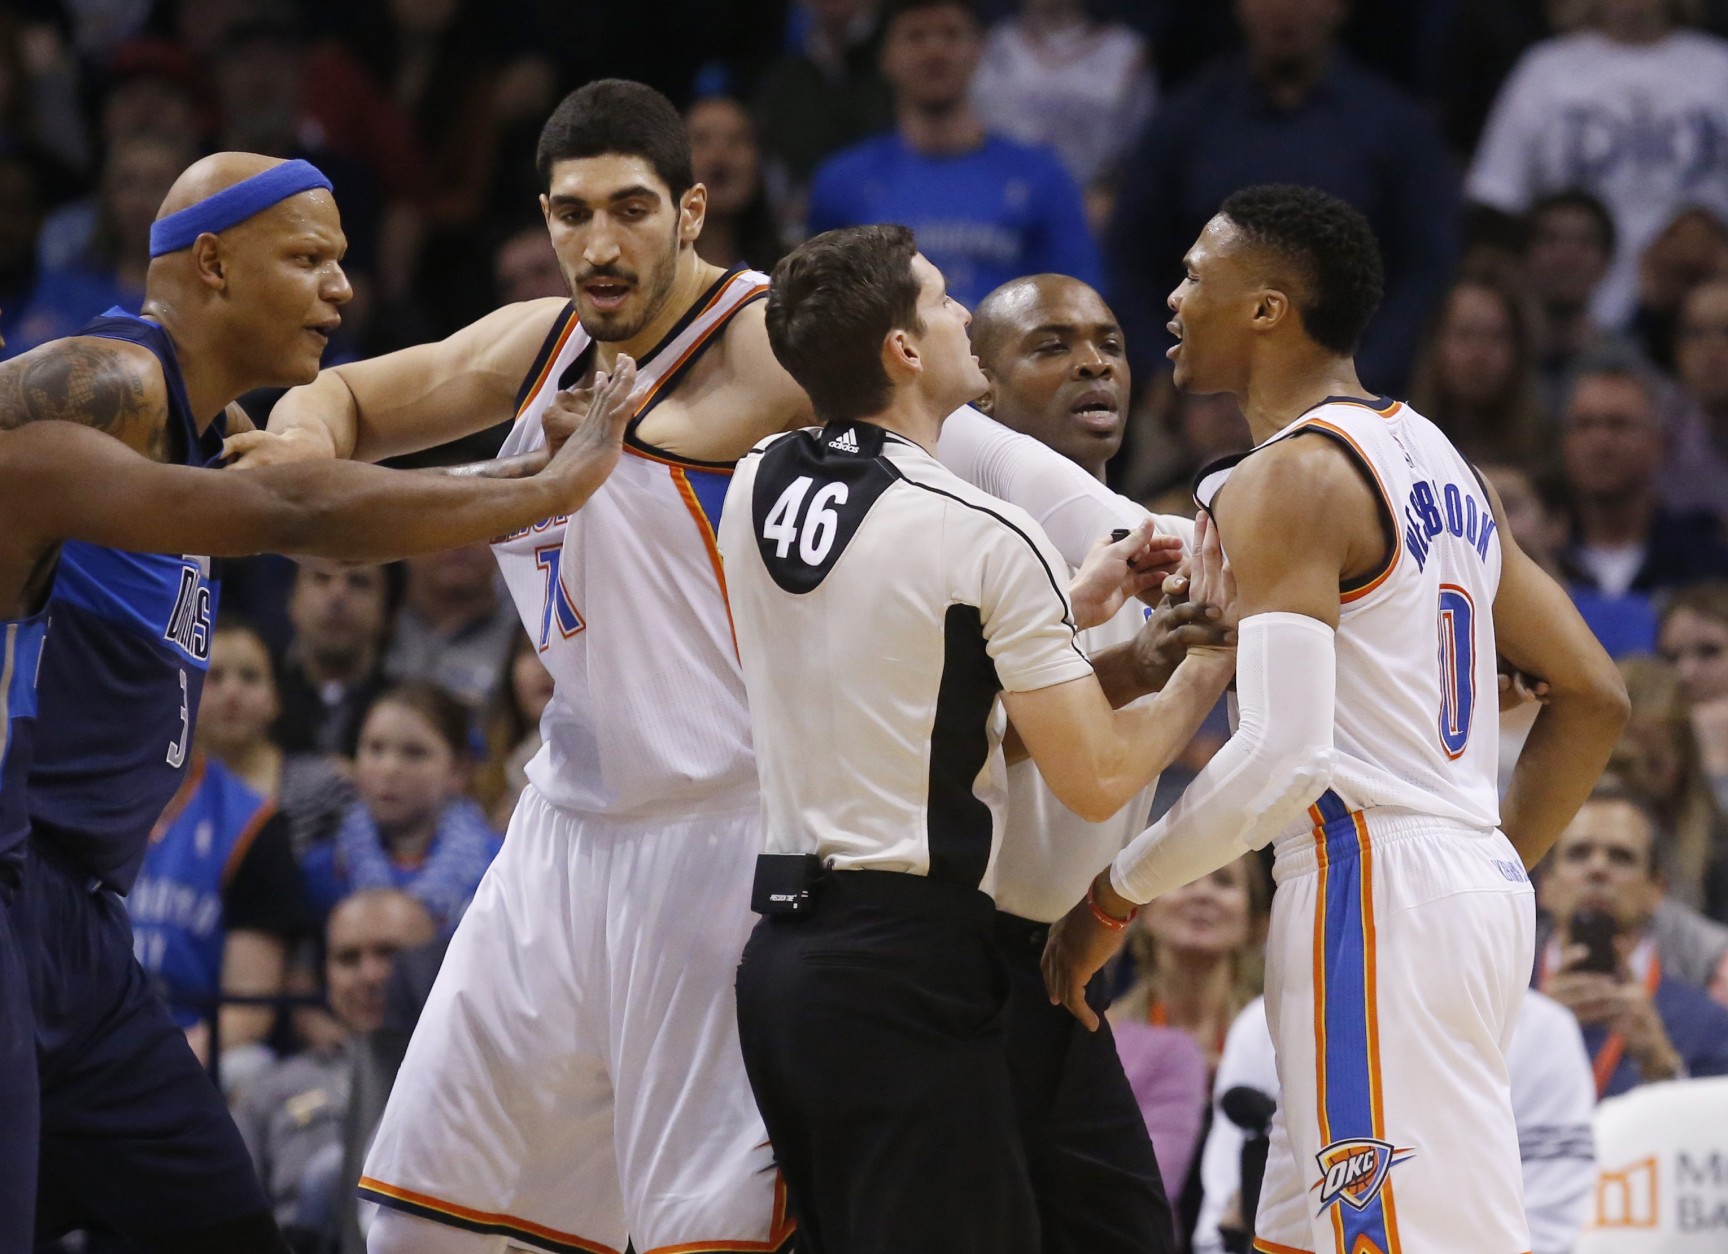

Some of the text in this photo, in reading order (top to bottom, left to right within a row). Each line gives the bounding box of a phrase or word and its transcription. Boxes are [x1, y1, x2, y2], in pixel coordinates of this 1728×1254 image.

[828, 440, 860, 454] adidas
[763, 475, 849, 567] 46
[165, 668, 189, 769] 3
[1437, 583, 1477, 762] 0
[1320, 1148, 1376, 1203] OKC
